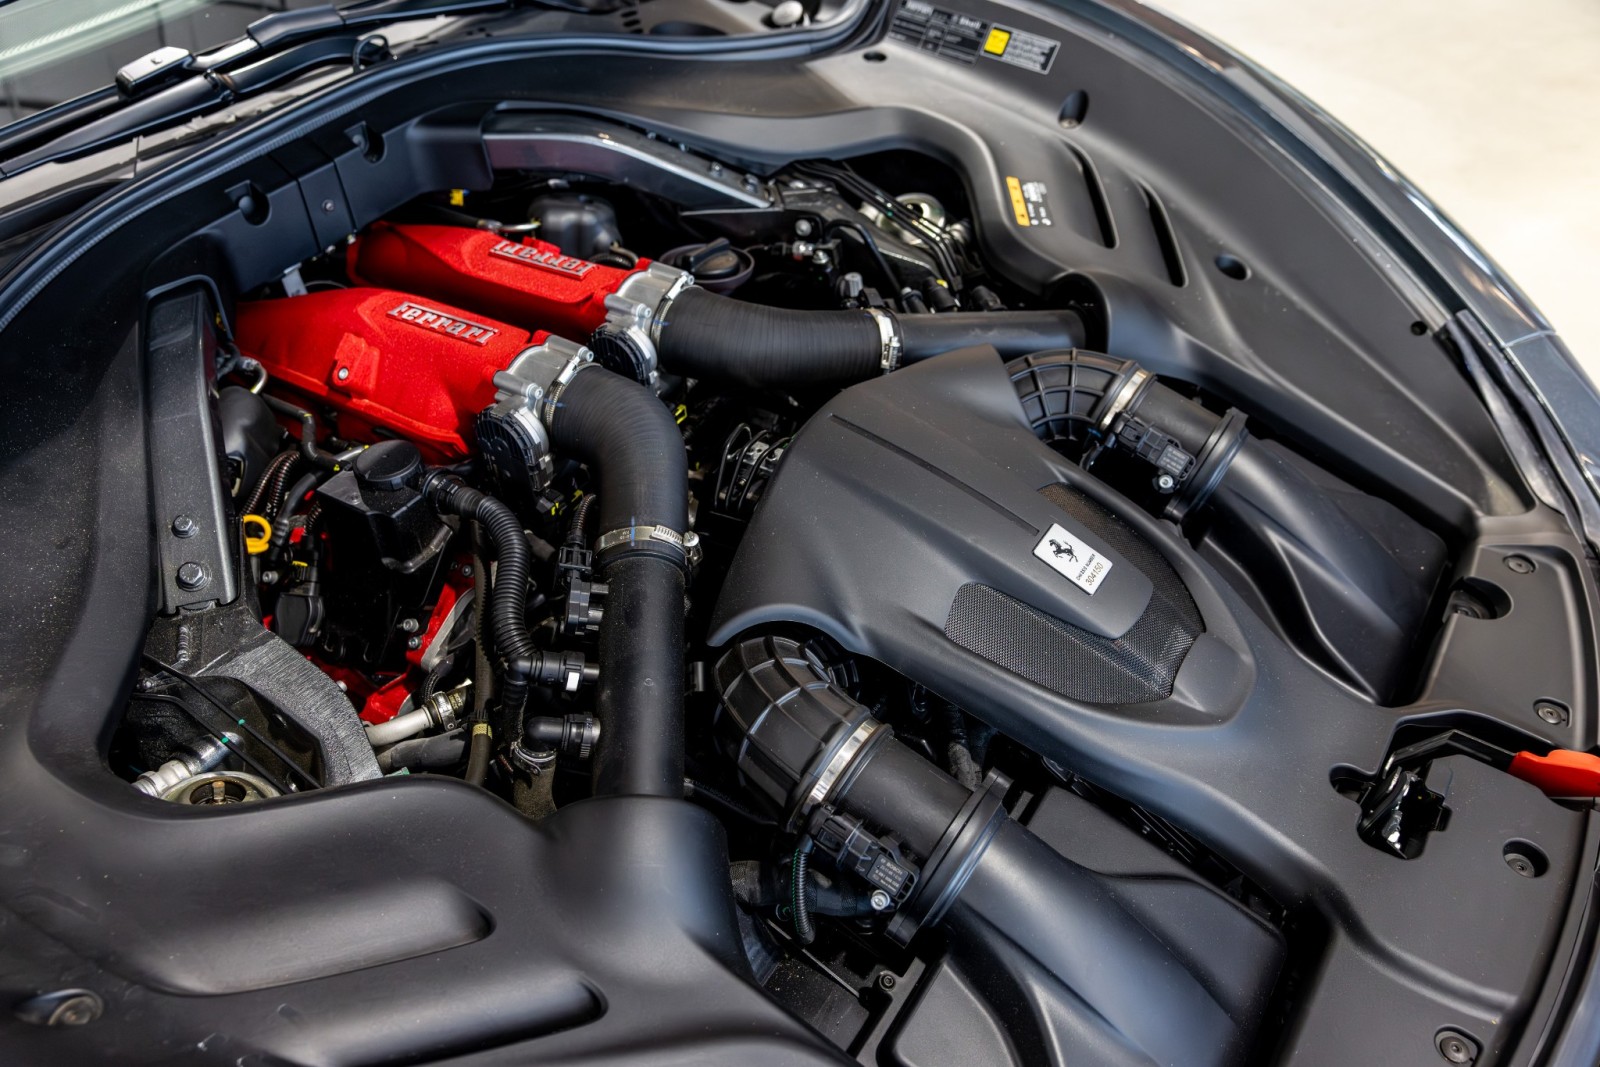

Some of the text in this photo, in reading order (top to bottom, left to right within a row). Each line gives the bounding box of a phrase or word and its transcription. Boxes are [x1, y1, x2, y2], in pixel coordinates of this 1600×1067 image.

[489, 240, 595, 279] Ferrari
[390, 301, 498, 344] Ferrari
[1085, 562, 1103, 586] 304150
